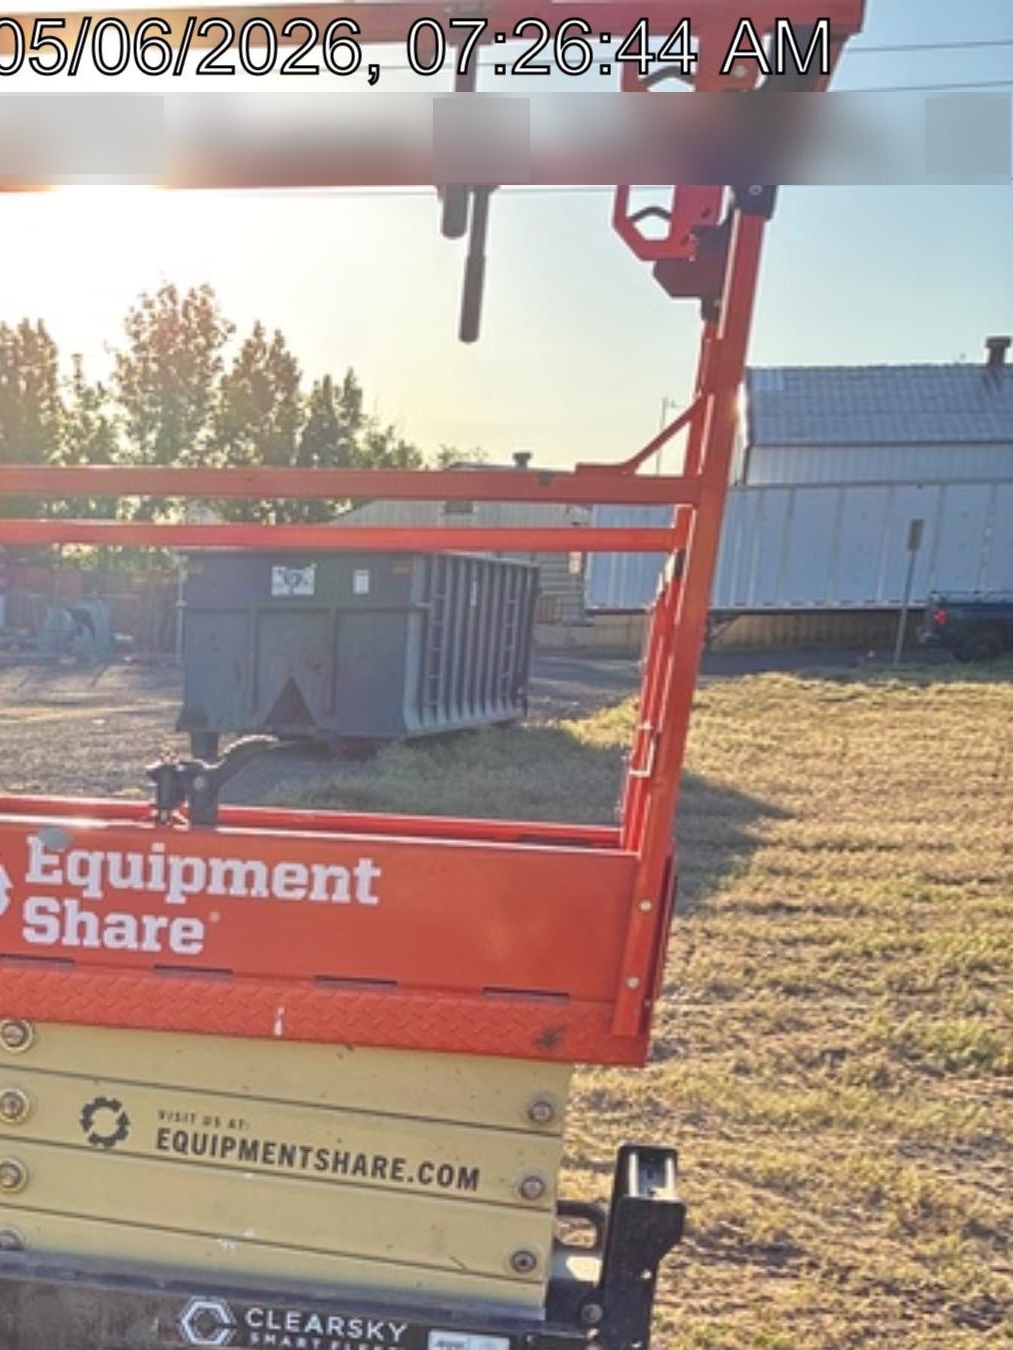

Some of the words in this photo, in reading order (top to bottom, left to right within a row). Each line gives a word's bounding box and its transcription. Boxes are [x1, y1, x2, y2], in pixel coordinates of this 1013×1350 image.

[25, 835, 382, 905] Equipment
[22, 897, 205, 955] Share
[156, 1127, 480, 1190] EQUIPMENTSHARE.COM
[244, 1307, 407, 1342] CLEARSKY
[249, 1332, 322, 1350] SMART
